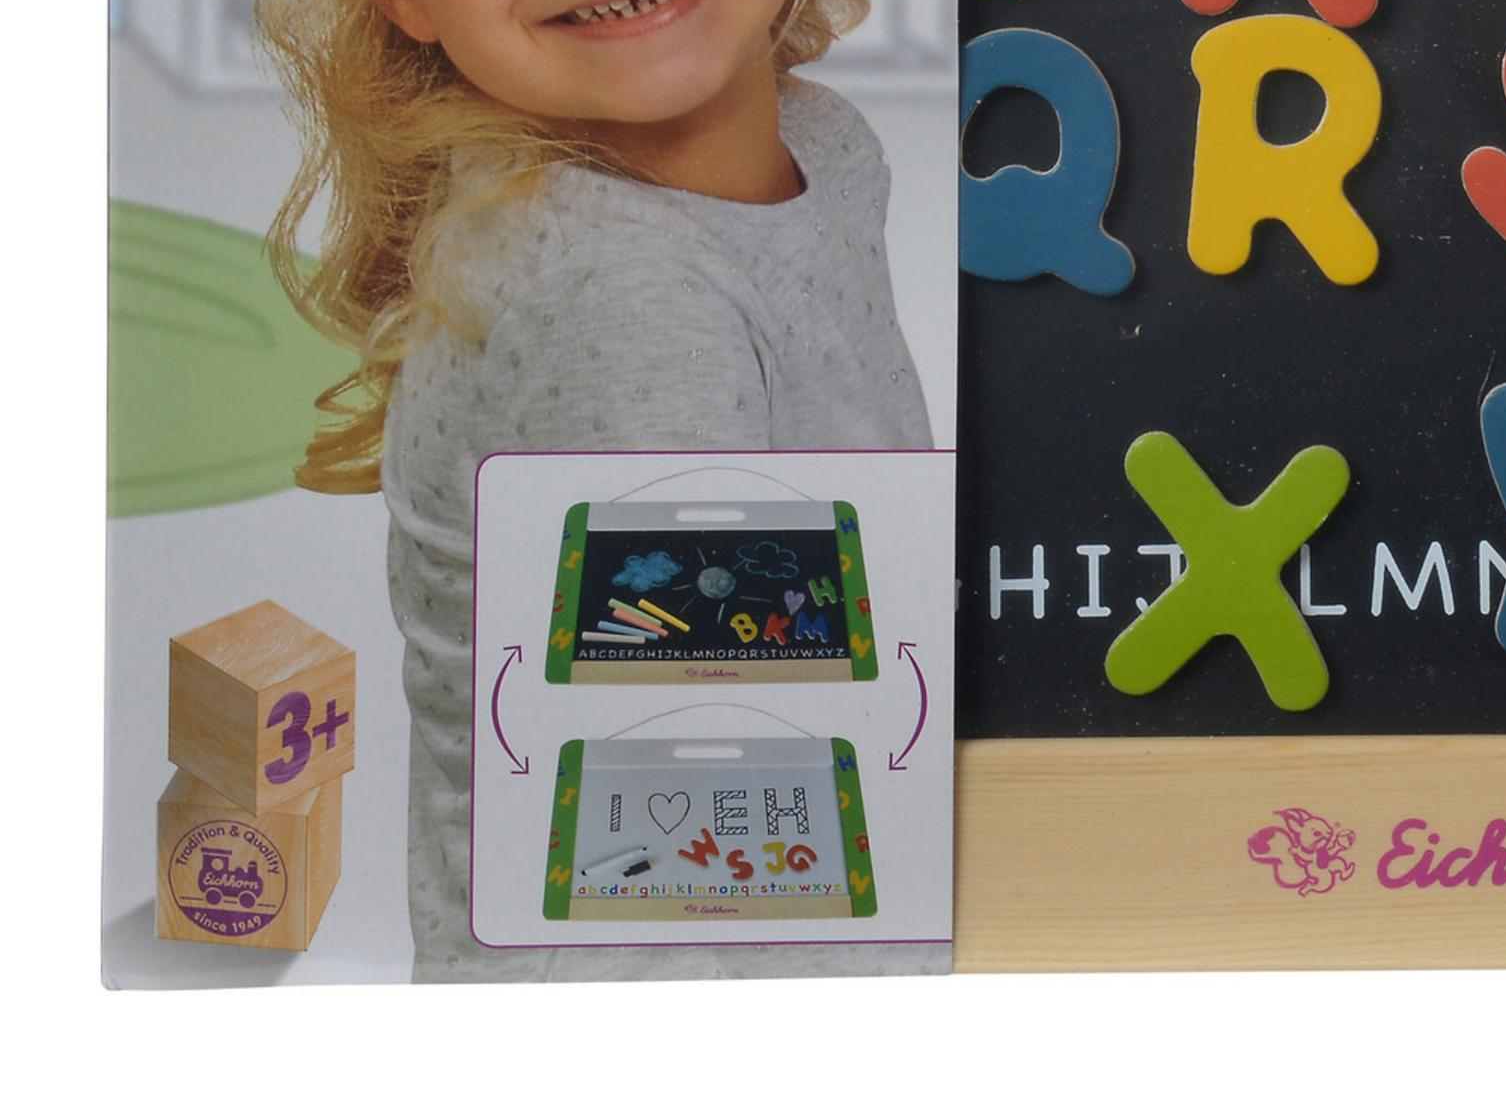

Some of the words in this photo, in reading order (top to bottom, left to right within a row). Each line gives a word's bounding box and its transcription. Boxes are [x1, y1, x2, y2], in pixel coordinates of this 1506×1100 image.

[264, 691, 350, 785] 3+
[176, 826, 225, 866] Tradition
[229, 825, 240, 837] &
[243, 830, 280, 875] Quality
[203, 872, 260, 890] Eichhorn
[194, 912, 228, 933] since
[232, 915, 262, 933] 1949
